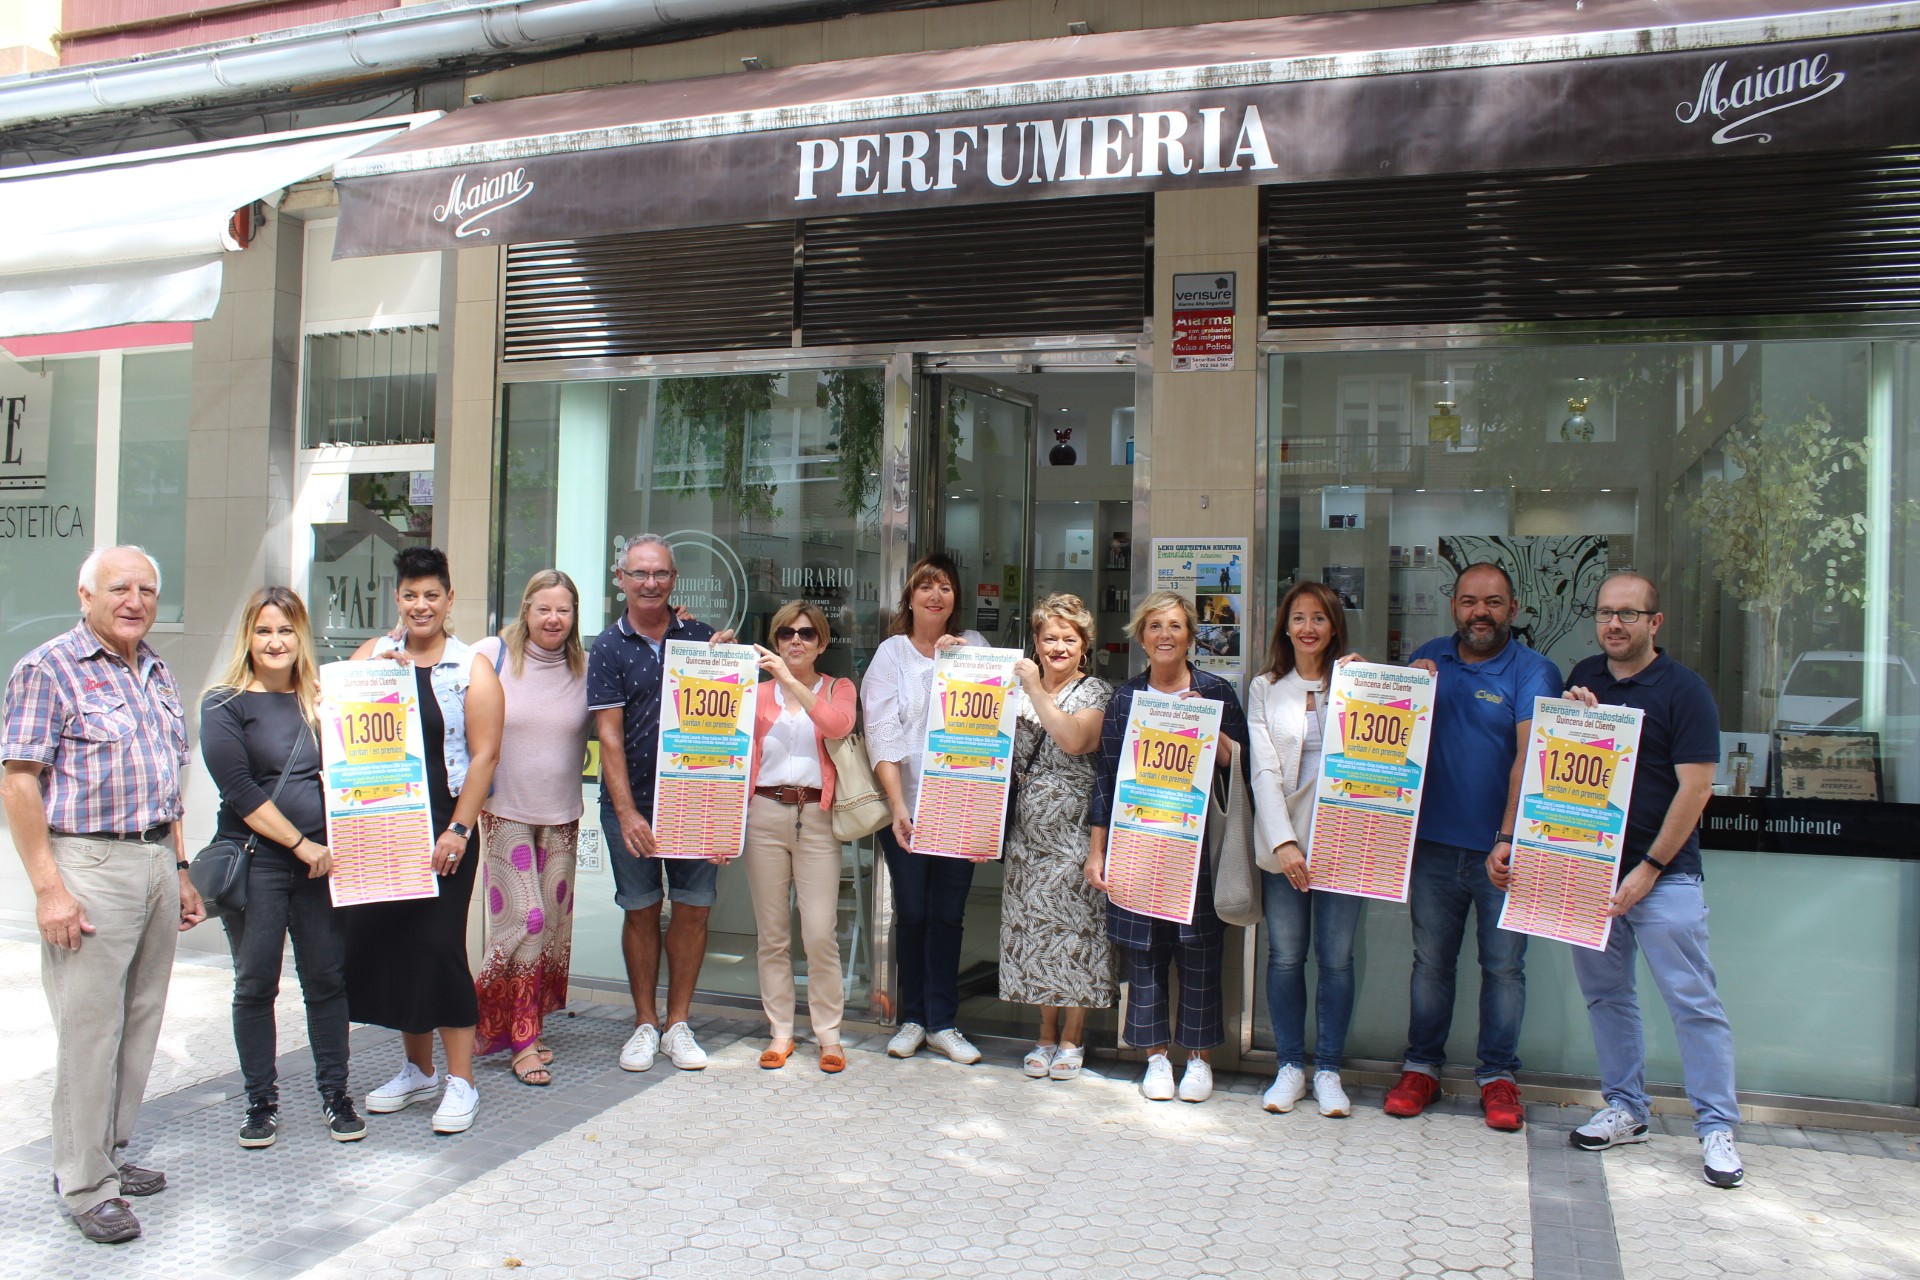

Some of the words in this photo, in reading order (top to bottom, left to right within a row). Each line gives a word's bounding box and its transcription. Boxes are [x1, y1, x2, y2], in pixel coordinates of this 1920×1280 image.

[1676, 53, 1846, 144] Maiane
[794, 105, 1278, 201] PERFUMERIA
[434, 168, 534, 237] Maiane
[1176, 290, 1231, 301] verisure
[1176, 315, 1232, 326] Alarma
[0, 394, 26, 466] E
[782, 567, 853, 588] HORARIO
[671, 646, 707, 657] Bezeroaren
[709, 649, 754, 660] Hamabostaldia
[686, 657, 711, 666] Quincena
[712, 658, 720, 666] del
[721, 659, 739, 667] Cliente
[1339, 668, 1377, 679] Bezeroaren
[1380, 671, 1430, 685] Hamabostaldia
[1354, 678, 1381, 689] Quincena
[1382, 681, 1392, 690] del
[1392, 682, 1413, 692] Cliente
[683, 688, 738, 718] 1.300€
[950, 690, 1000, 720] 1.300€
[1137, 697, 1170, 709] Bezeroaren
[1172, 701, 1217, 715] Hamabostaldia
[1149, 708, 1173, 718] Quincena
[1173, 711, 1181, 719] del
[1182, 712, 1200, 721] Cliente
[1541, 703, 1580, 717] Bezeroaren
[1583, 708, 1635, 724] Hamabostaldia
[1556, 715, 1583, 727] Quincena
[1584, 718, 1594, 729] del
[1594, 719, 1616, 731] Cliente
[346, 712, 403, 744] 1.300€
[713, 720, 734, 729] premios
[1350, 711, 1409, 747] 1.300€
[1142, 739, 1195, 774] 1.300€
[1380, 748, 1405, 758] premios
[1550, 750, 1612, 789] 1.300€
[1168, 775, 1191, 785] premios
[1580, 789, 1606, 800] premios
[1711, 814, 1759, 831] medio
[1764, 815, 1842, 835] ambiente
